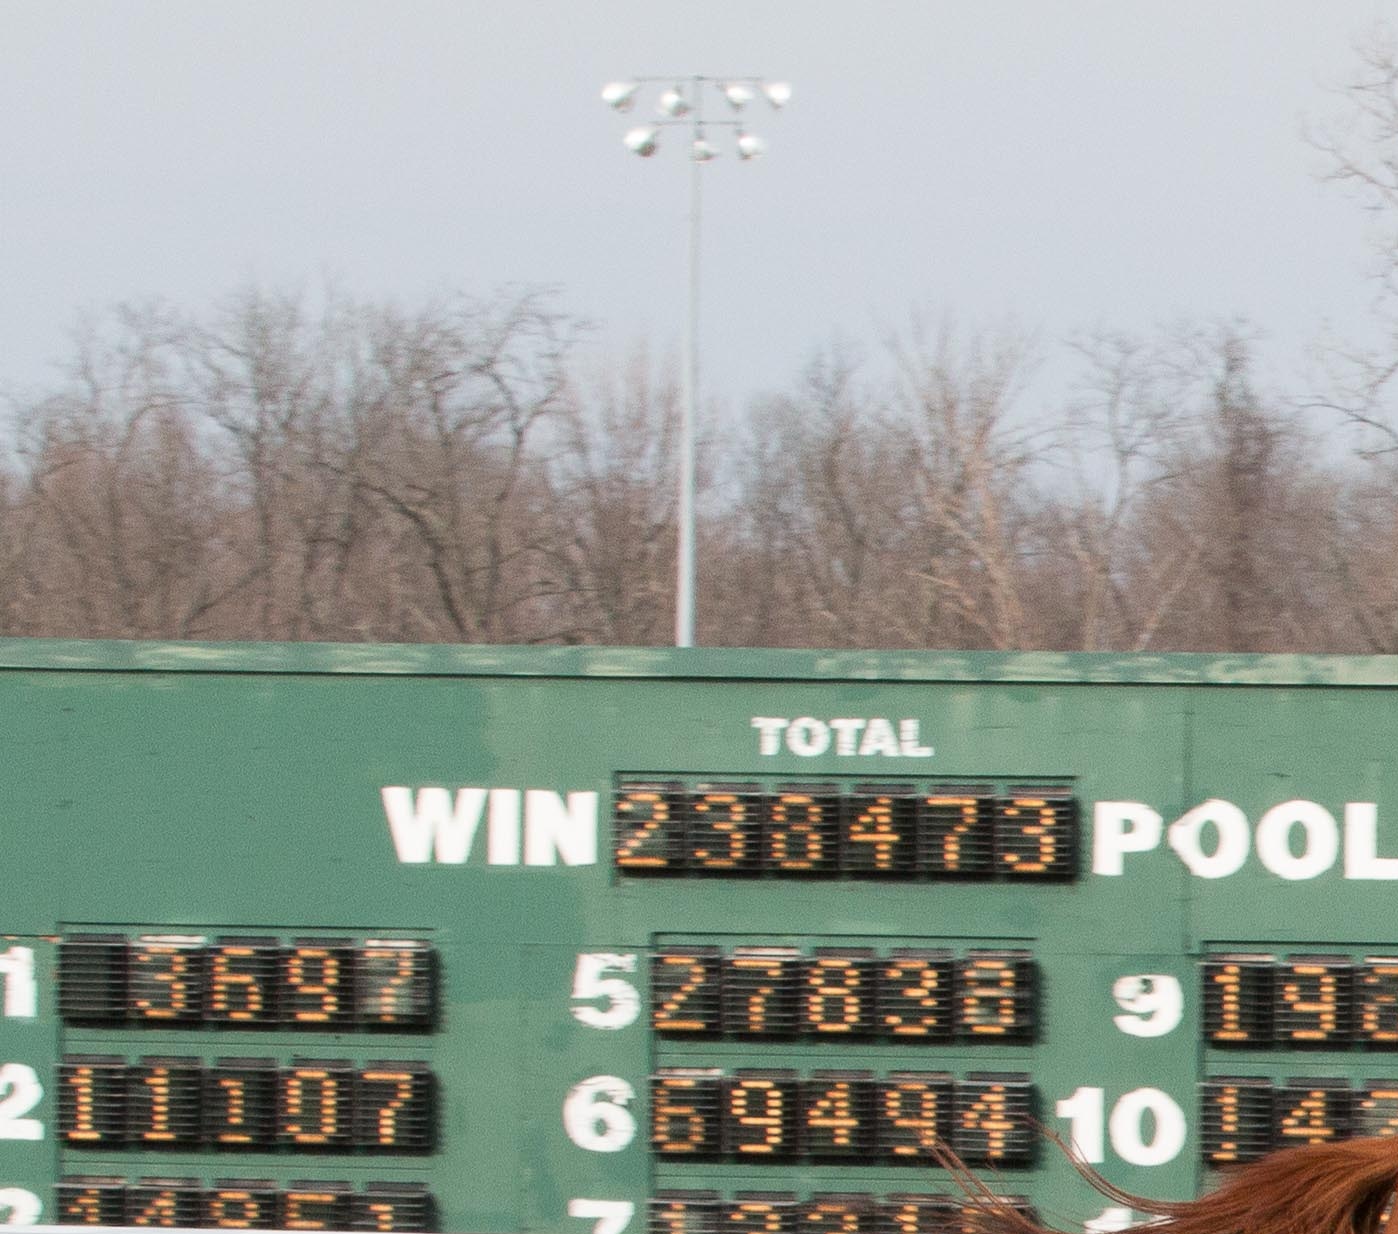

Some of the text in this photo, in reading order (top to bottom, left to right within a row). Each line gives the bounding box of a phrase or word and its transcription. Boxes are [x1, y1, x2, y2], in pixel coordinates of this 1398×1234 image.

[751, 716, 935, 758] TOTAL
[380, 786, 599, 866] WIN
[615, 793, 1056, 873] 238473
[135, 946, 414, 1022] 3697
[569, 952, 641, 1030] 5
[653, 955, 1015, 1035] 27838
[1112, 973, 1184, 1038] 9
[0, 1062, 45, 1140] 2
[67, 1066, 414, 1145] 11107
[562, 1074, 637, 1153] 6
[652, 1078, 1015, 1158] 69494
[1056, 1086, 1187, 1167] 10
